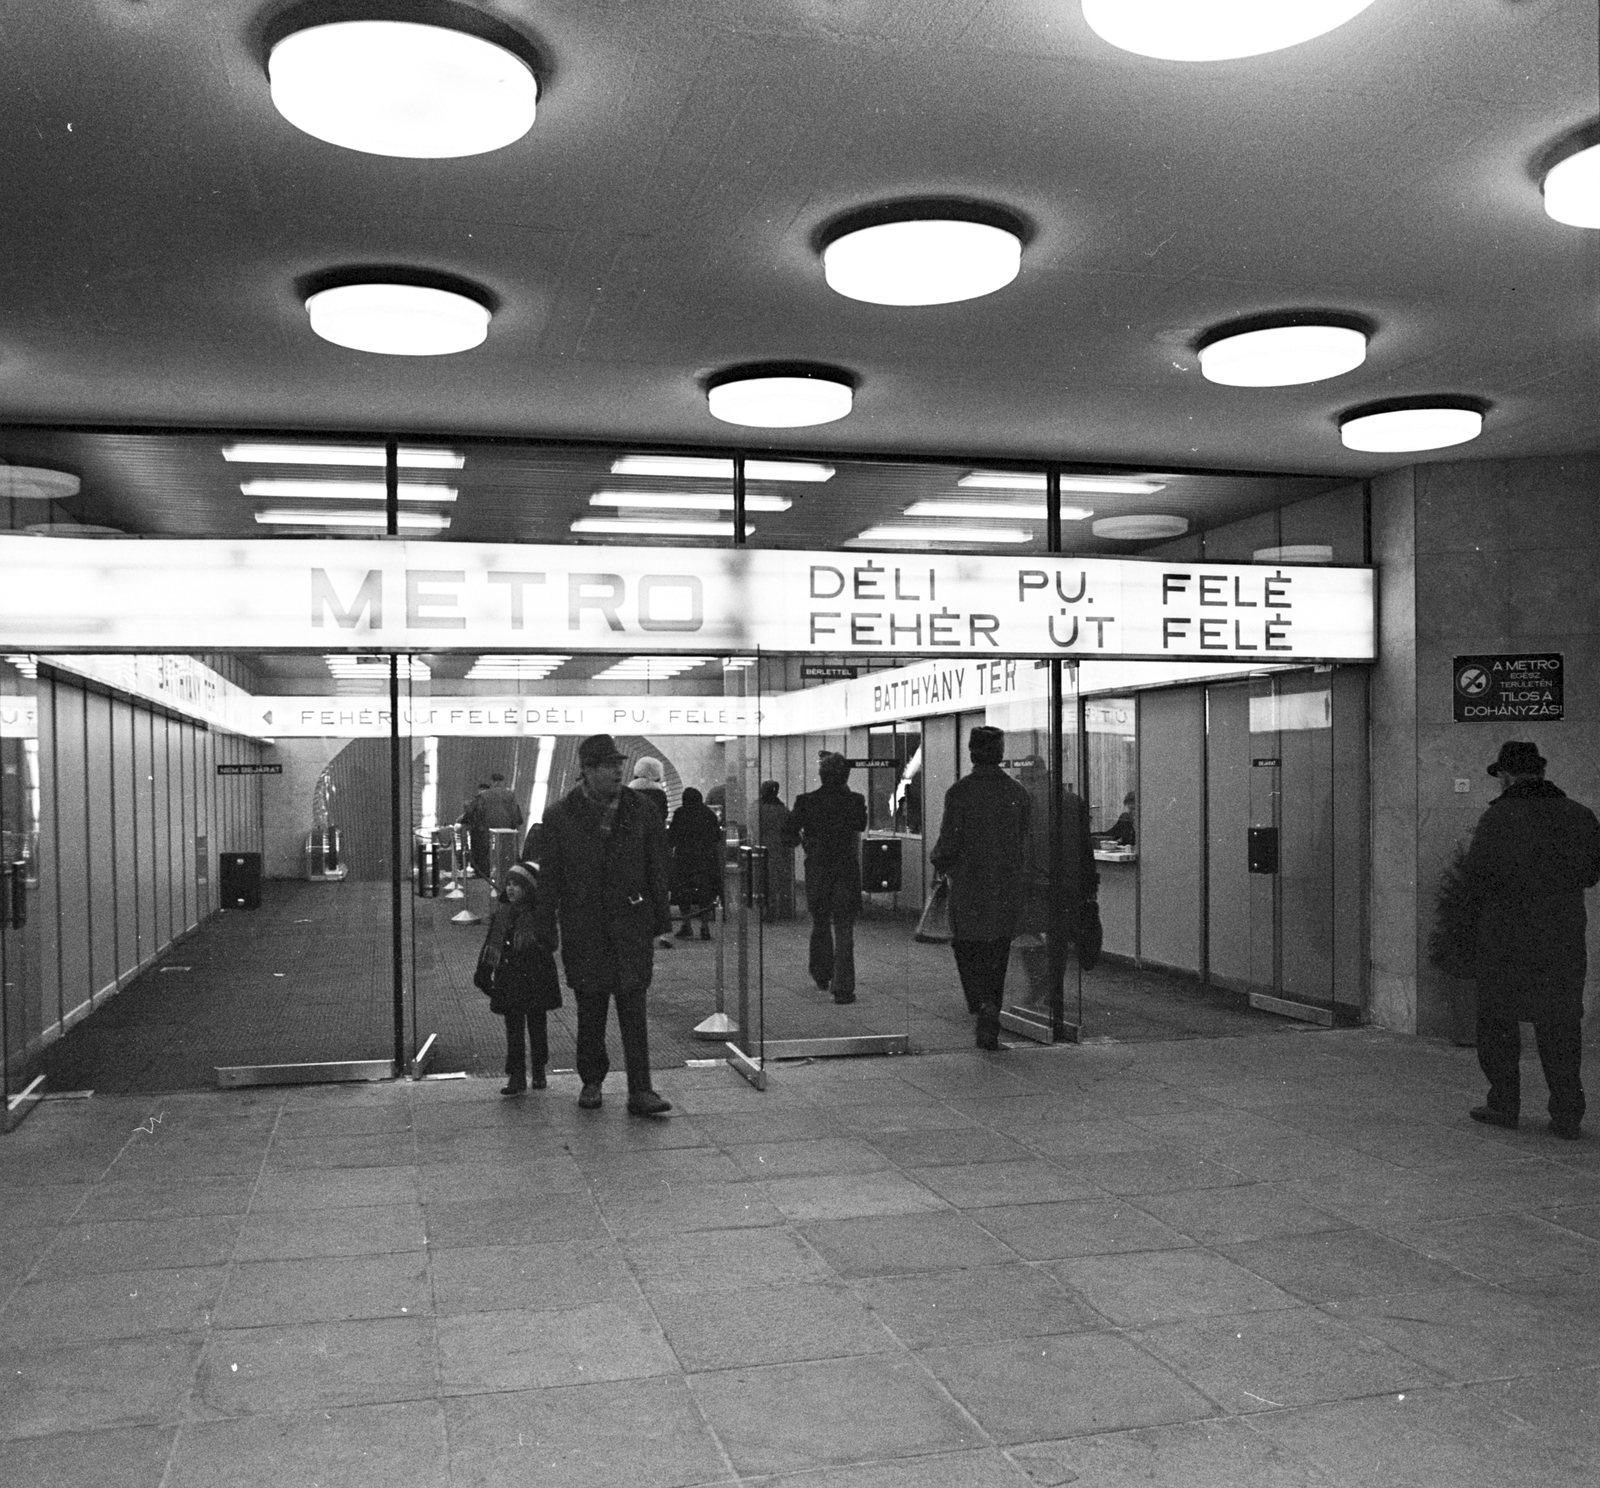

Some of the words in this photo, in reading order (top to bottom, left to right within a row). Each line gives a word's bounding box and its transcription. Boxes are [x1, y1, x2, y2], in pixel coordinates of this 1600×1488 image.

[809, 559, 936, 601] DÉLI
[1018, 570, 1094, 603] PU.
[1162, 570, 1293, 608] FELÉ
[310, 567, 704, 632] METRO
[809, 606, 1000, 647] FEHÉR
[1048, 608, 1115, 648] ÚT
[1162, 613, 1293, 651] FELÉ
[1492, 661, 1503, 671] A
[1505, 659, 1560, 671] METRO
[874, 663, 965, 713] BATTHYÁNY
[1499, 691, 1540, 702] TILOS
[1542, 691, 1553, 701] A
[301, 707, 391, 725] FEHÉR
[450, 707, 518, 724] FELÉ
[526, 707, 584, 724] DÉLI
[613, 709, 650, 723] PU.
[1464, 702, 1563, 716] DOHÁNYZÁS!
